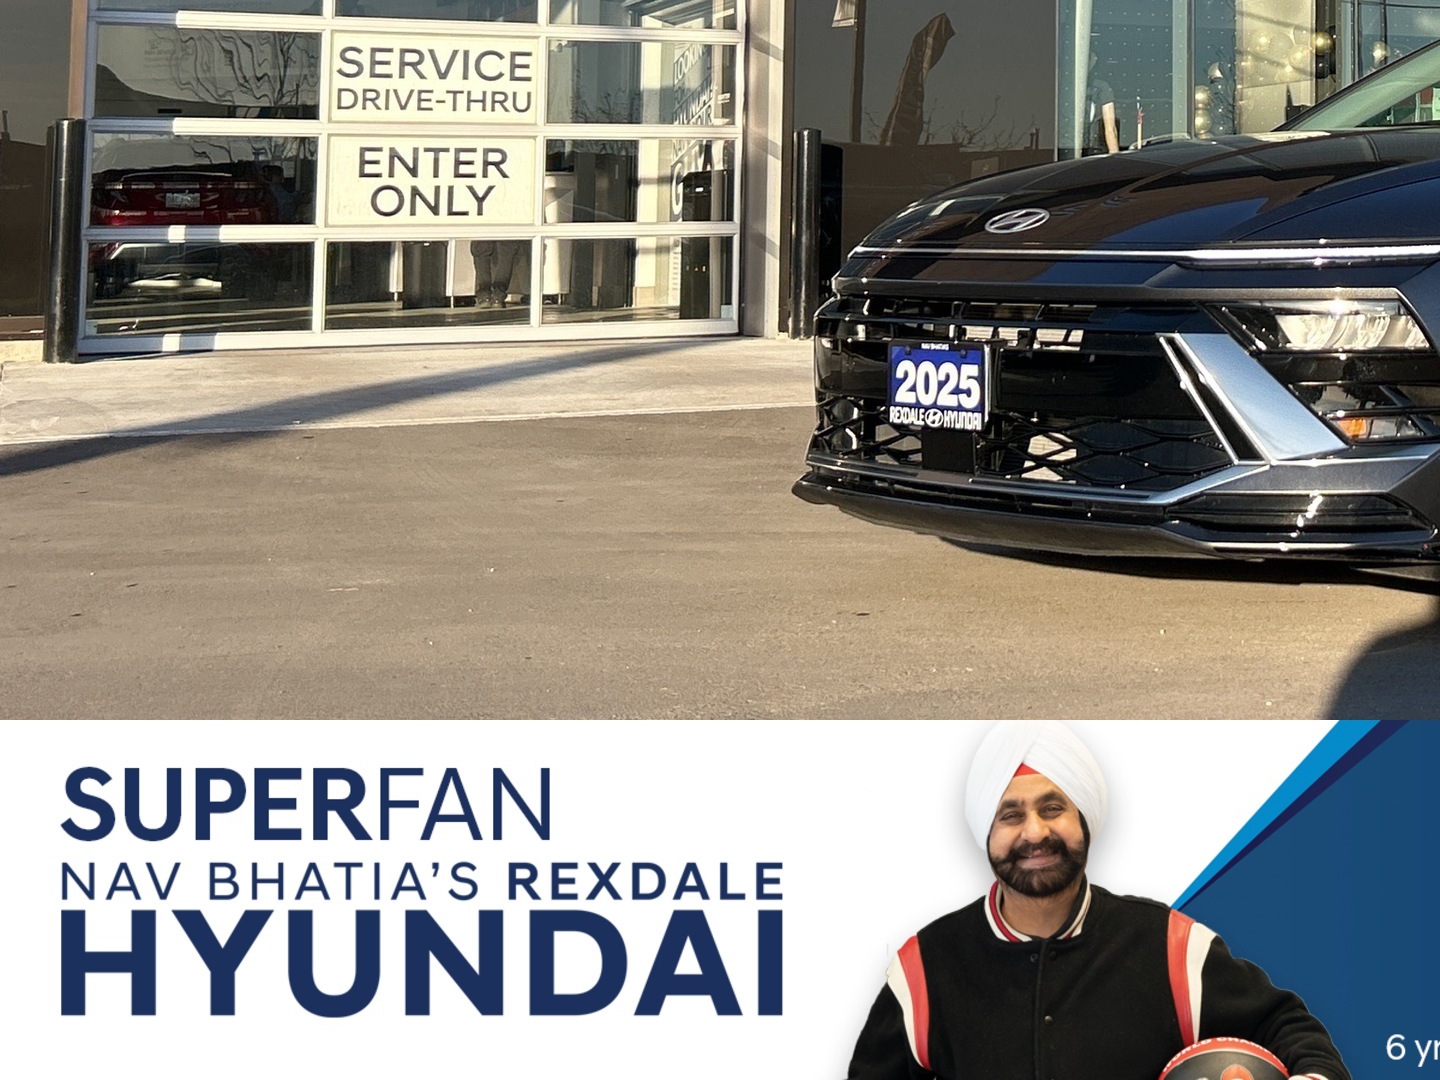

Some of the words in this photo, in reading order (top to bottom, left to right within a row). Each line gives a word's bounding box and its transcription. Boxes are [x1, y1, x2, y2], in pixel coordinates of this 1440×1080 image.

[336, 46, 533, 82] SERVICE
[337, 88, 532, 113] DRIVE-THRU
[358, 146, 510, 179] ENTER
[370, 184, 496, 217] ONLY
[894, 359, 980, 409] 2025
[889, 406, 925, 425] REXDALE
[943, 410, 982, 430] HYUNDAI
